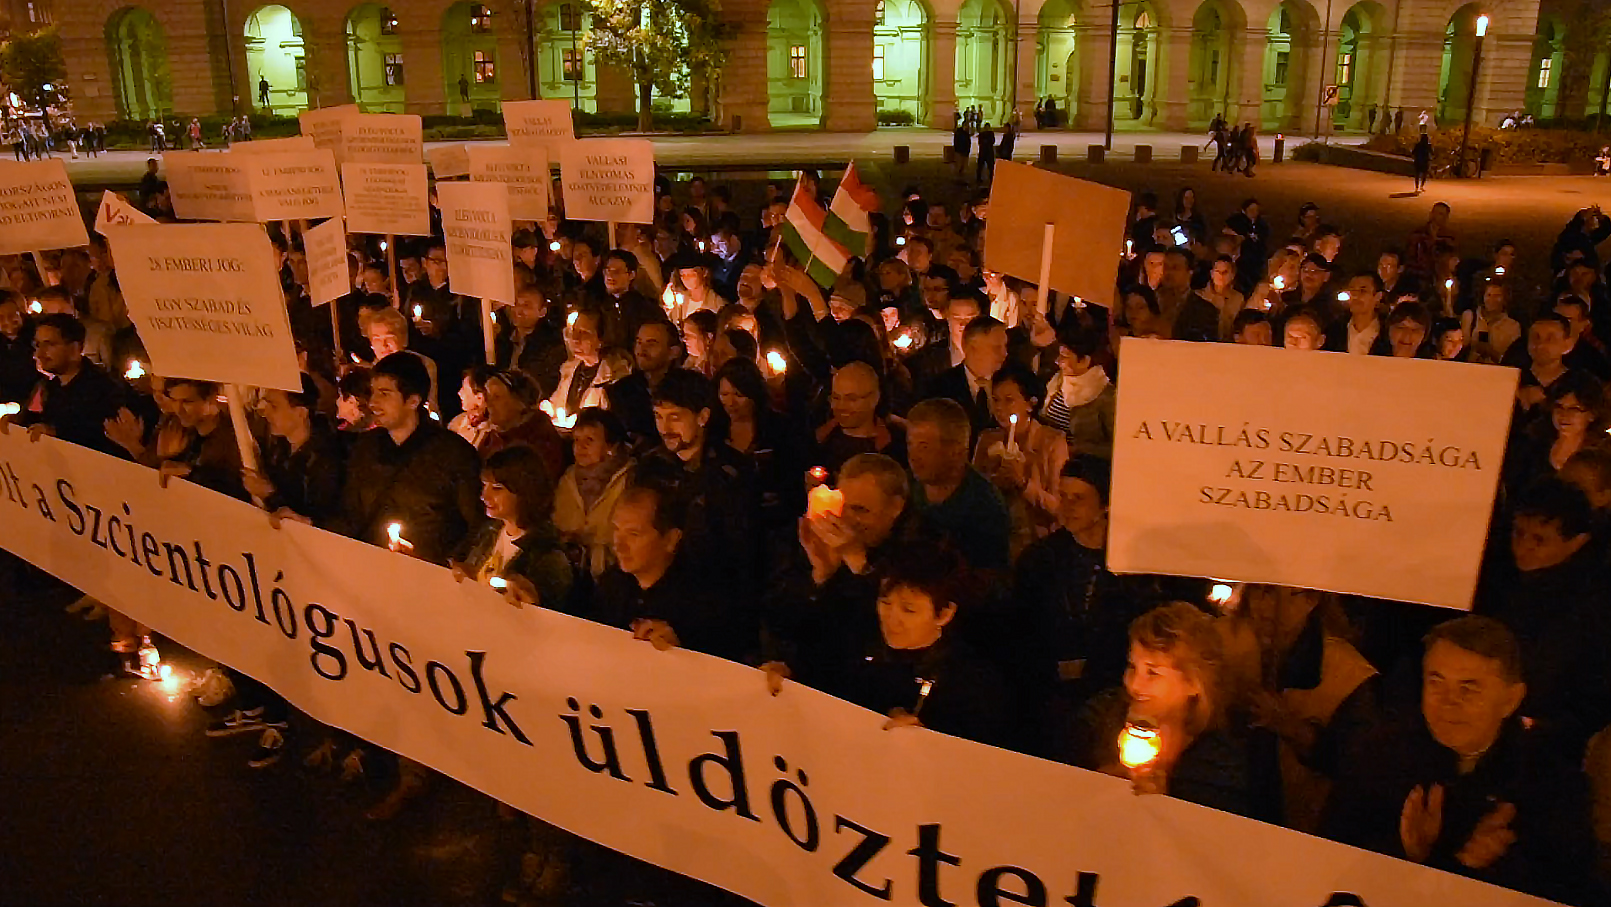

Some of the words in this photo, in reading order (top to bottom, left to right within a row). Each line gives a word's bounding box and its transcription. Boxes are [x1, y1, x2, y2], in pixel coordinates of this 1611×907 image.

[163, 257, 213, 273] EMBERI
[154, 298, 183, 312] EGY
[184, 298, 234, 314] SZABAD
[1133, 420, 1155, 441] A
[1160, 420, 1271, 450] VALLÁS
[1279, 430, 1483, 471] SZABADSÁGA
[1226, 460, 1265, 481] AZ
[1272, 463, 1374, 491] EMBER
[1199, 486, 1394, 522] SZABADSÁGA
[0, 461, 28, 510] lt
[32, 483, 57, 522] a
[57, 477, 534, 747] Szcientológusok
